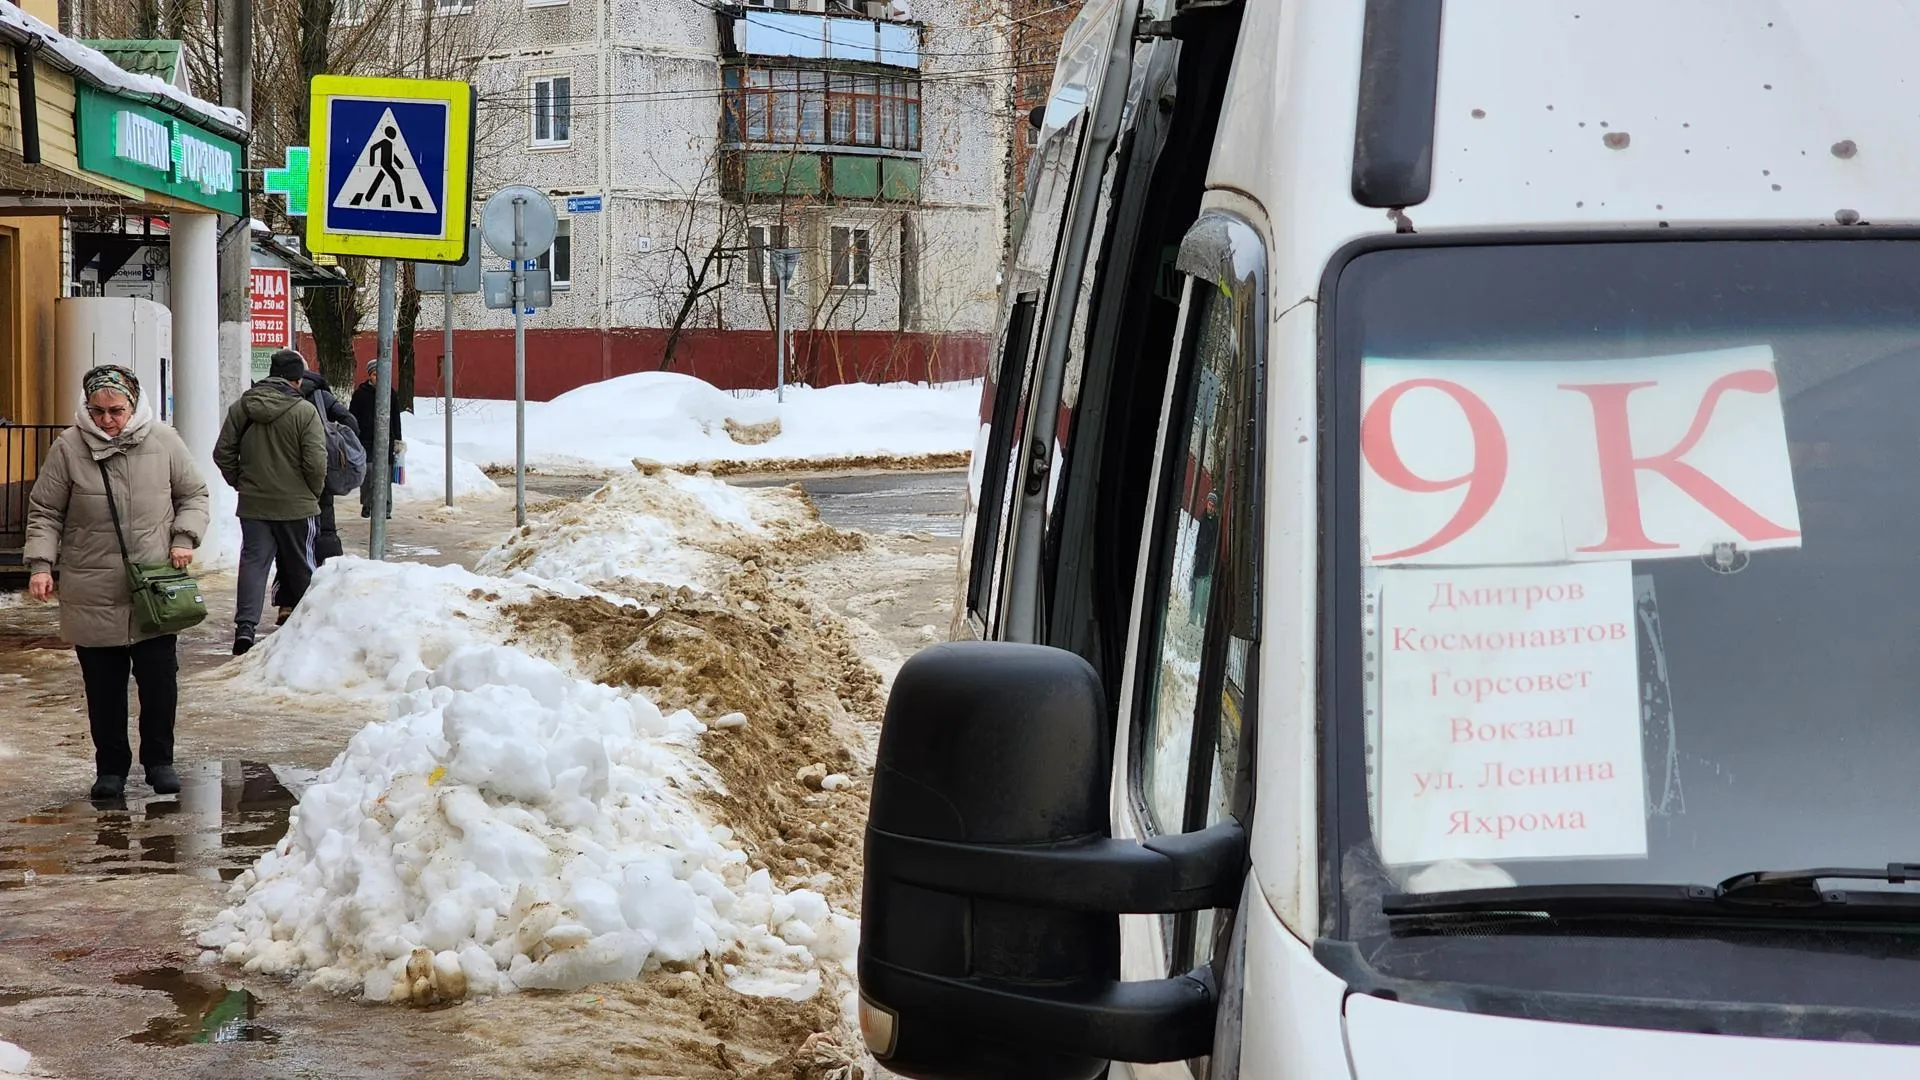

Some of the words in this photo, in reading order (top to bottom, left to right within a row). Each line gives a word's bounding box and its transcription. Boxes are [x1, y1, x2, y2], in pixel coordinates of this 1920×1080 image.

[121, 110, 171, 173] АПТЕКИ
[178, 133, 234, 195] ГОРЗДРАВ
[568, 200, 576, 210] 28
[145, 267, 152, 277] 3
[263, 300, 275, 309] 250
[255, 333, 266, 343] 137
[267, 320, 275, 330] 22
[276, 320, 283, 330] 12
[1427, 581, 1586, 616] Дмитров
[1391, 621, 1628, 653] Космонавтов
[1429, 669, 1594, 704] Горсовет
[1449, 716, 1576, 745] Вокзал
[1412, 769, 1464, 798] ул.
[1476, 760, 1615, 789] Ленина
[1445, 808, 1587, 841] Яхрома
